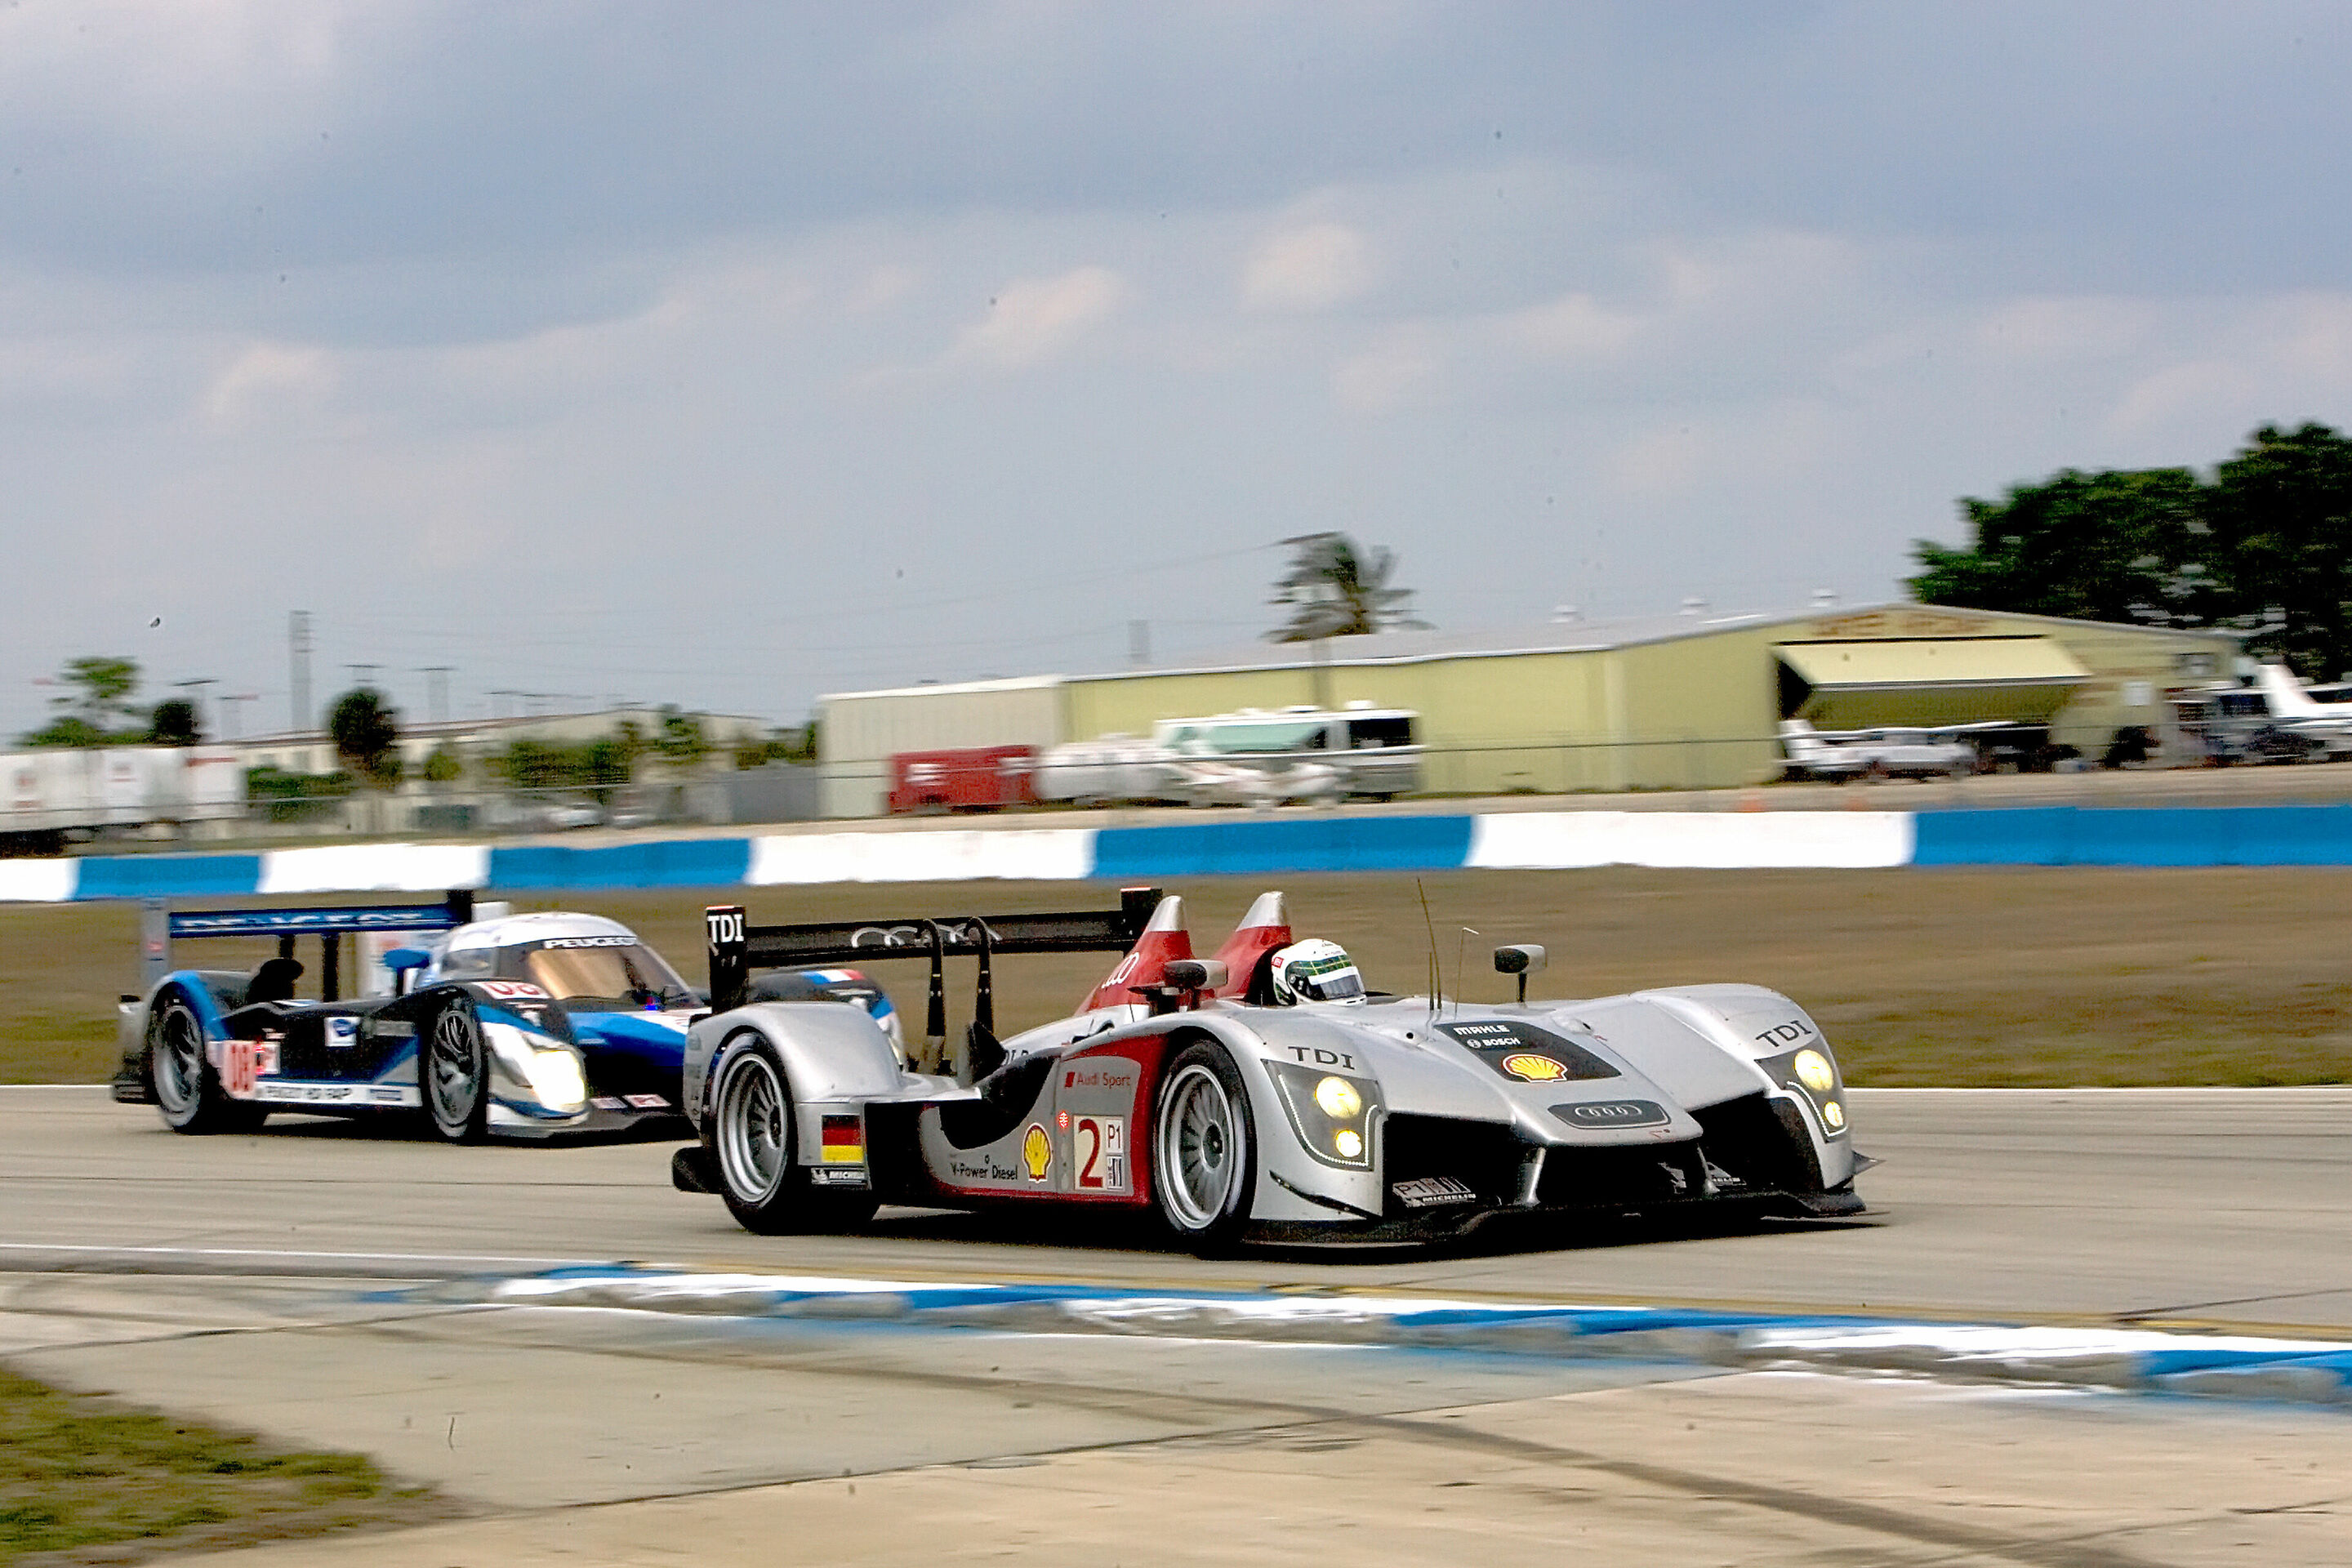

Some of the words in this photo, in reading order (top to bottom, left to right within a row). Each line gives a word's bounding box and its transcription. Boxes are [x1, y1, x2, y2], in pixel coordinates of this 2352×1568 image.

[707, 914, 744, 943] TDI
[1453, 1025, 1510, 1036] MAHLE
[1481, 1037, 1521, 1046] BOSCH
[1755, 1020, 1812, 1047] TDI
[1288, 1046, 1355, 1070] TDI
[1077, 1071, 1099, 1086] Audi
[1102, 1072, 1131, 1089] Sport
[1107, 1124, 1121, 1150] P1
[1079, 1118, 1103, 1188] 2
[950, 1162, 989, 1178] V-Power
[991, 1164, 1018, 1180] Diesel
